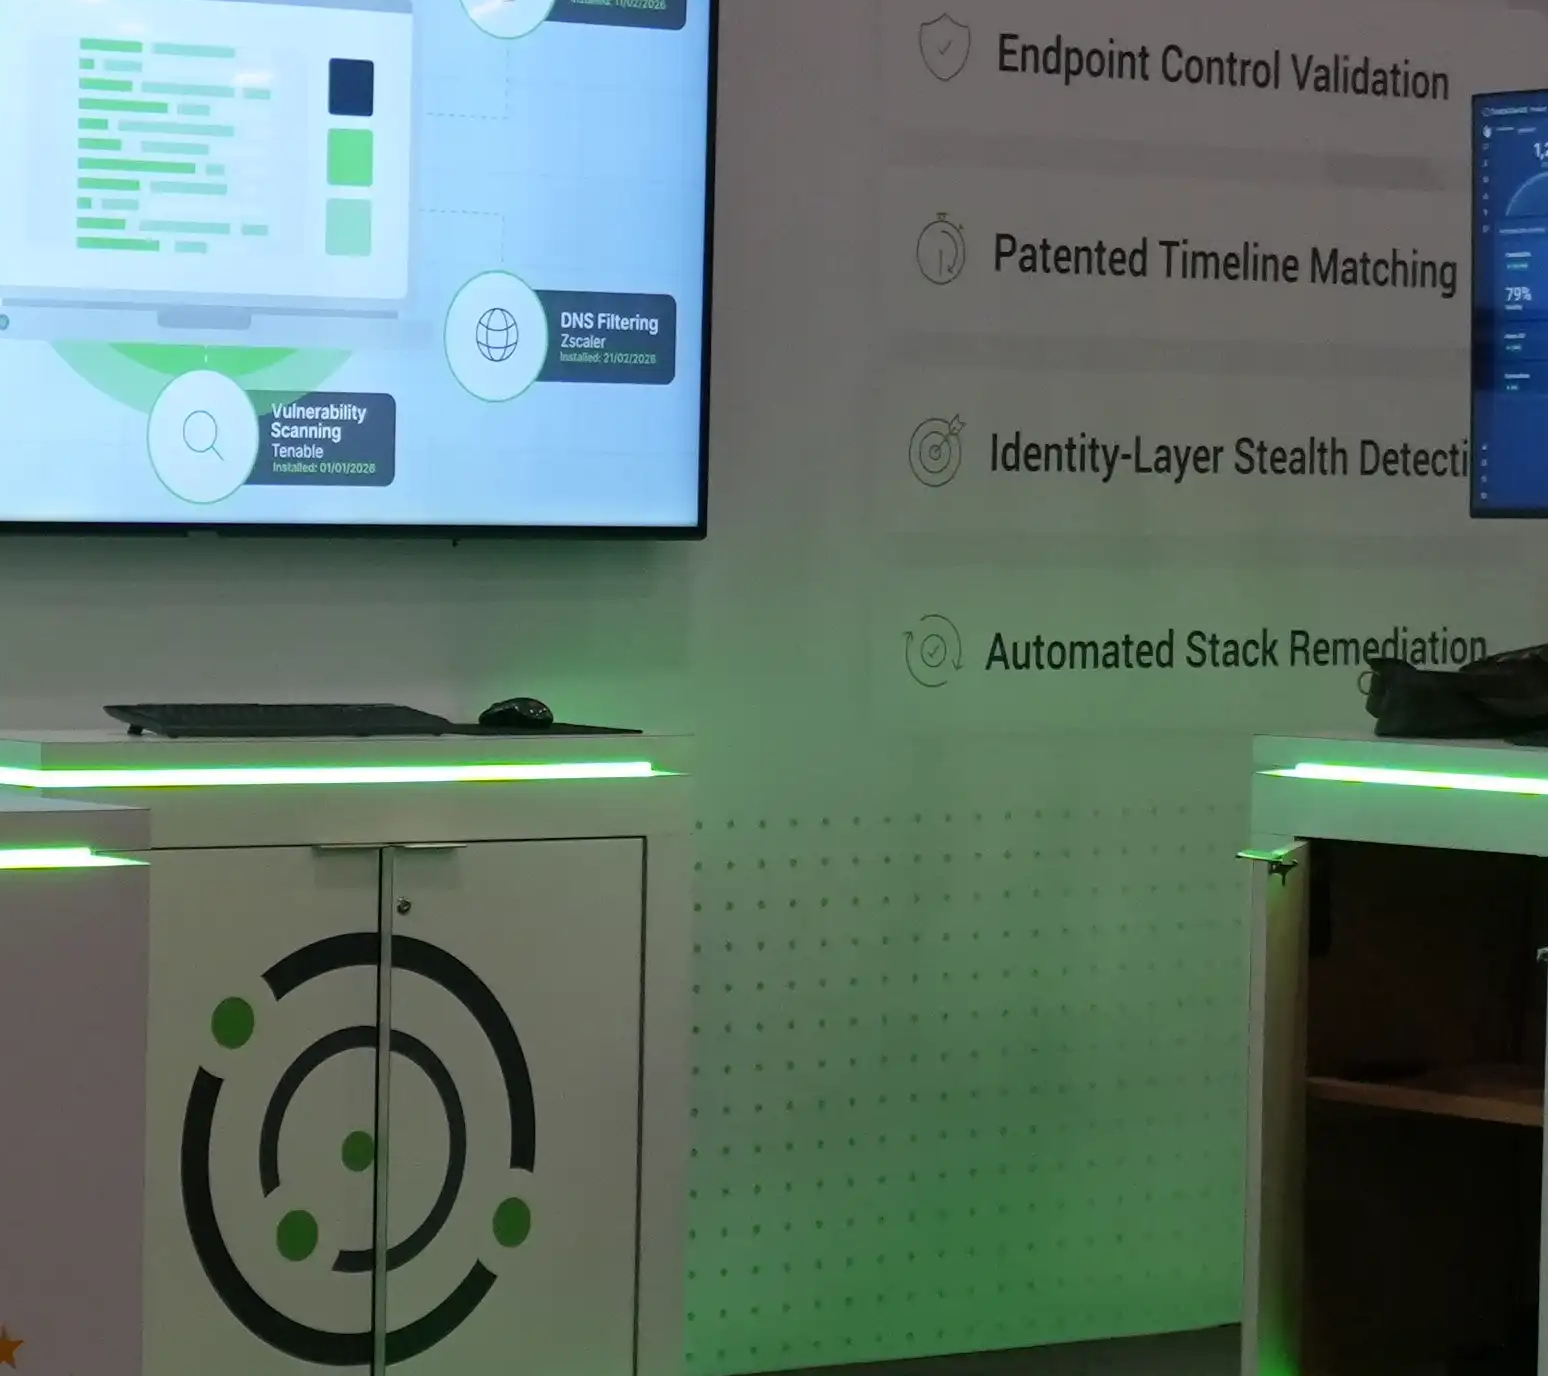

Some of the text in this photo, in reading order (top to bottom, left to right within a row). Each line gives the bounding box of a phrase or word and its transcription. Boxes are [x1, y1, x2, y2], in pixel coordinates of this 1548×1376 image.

[998, 32, 1449, 100] Endpoint Control Validation
[994, 231, 1458, 299] Patented Timeline Matching
[560, 312, 659, 335] DNS Filtering
[560, 334, 606, 350] Zscaler
[559, 352, 601, 365] Installed:
[271, 403, 367, 424] Vulnerability
[271, 422, 342, 443] Scanning
[272, 443, 324, 459] Tenable
[990, 431, 1468, 484] Identity-Layer Stealth Detecti
[273, 462, 318, 474] Installed:
[985, 625, 1488, 671] Automated Stack Remediation
